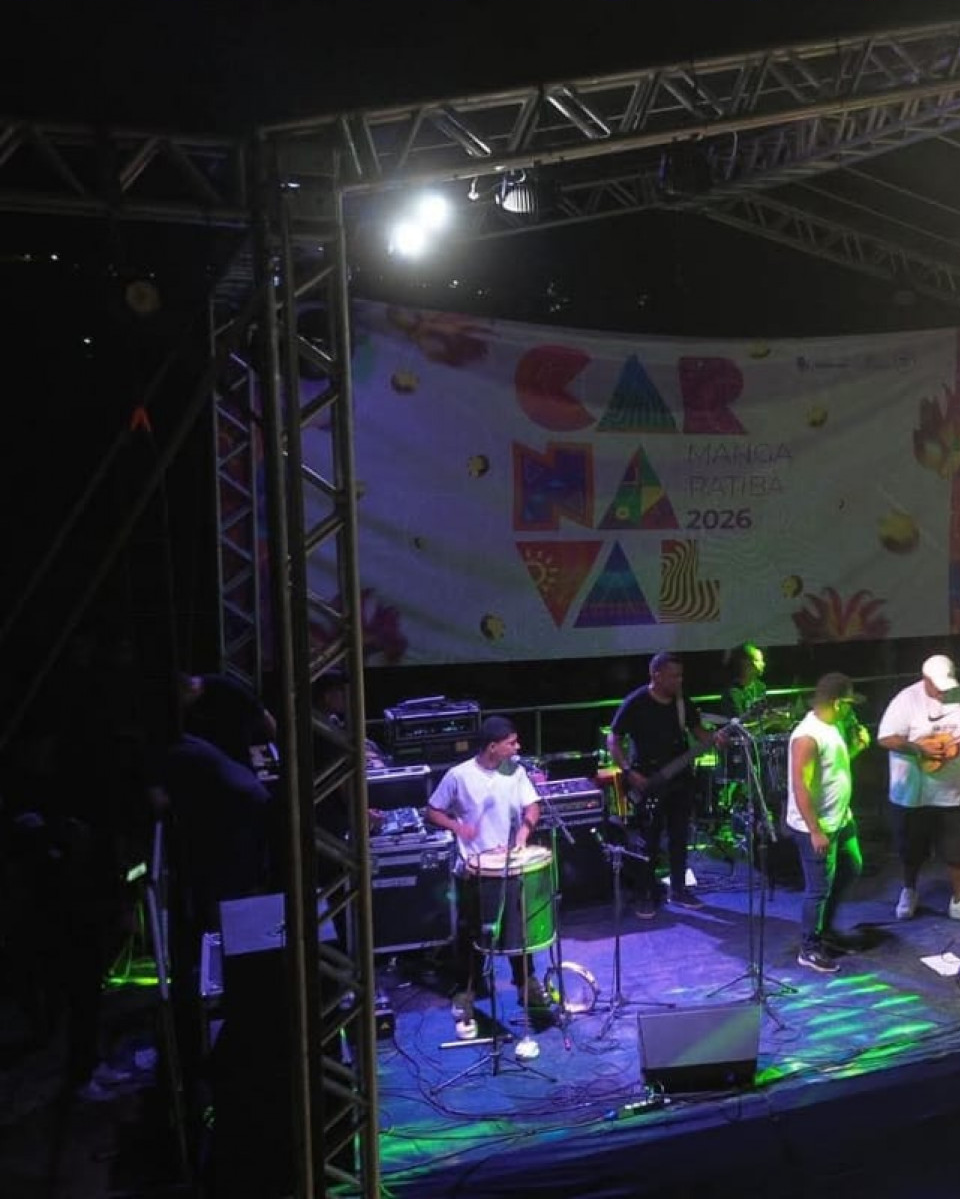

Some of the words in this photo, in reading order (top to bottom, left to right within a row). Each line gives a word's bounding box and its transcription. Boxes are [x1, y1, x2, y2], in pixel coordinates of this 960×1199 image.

[515, 345, 747, 435] CAR
[685, 442, 793, 466] MANGA
[512, 441, 680, 532] NA
[687, 475, 785, 498] RATIBA
[687, 508, 753, 530] 2026
[516, 539, 721, 629] VAL
